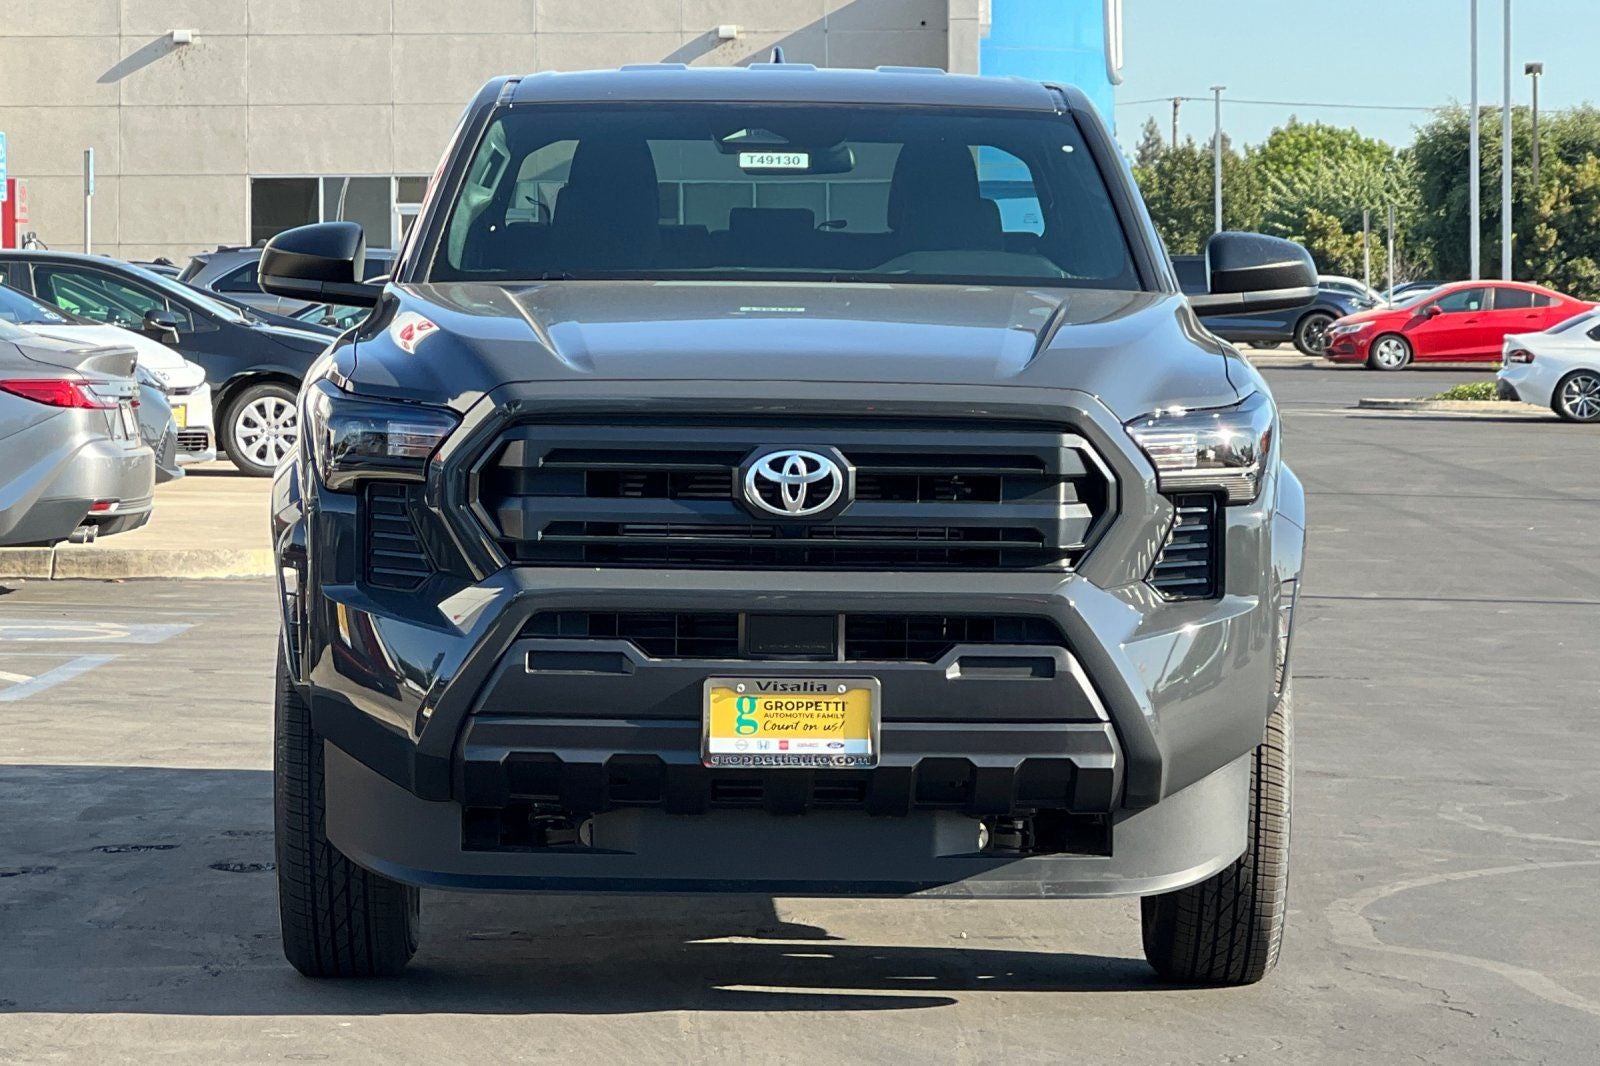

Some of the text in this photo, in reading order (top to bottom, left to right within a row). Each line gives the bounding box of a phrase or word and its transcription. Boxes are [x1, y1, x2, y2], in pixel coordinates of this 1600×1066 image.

[747, 155, 801, 165] T49130
[755, 681, 828, 693] Visalia
[763, 701, 846, 712] GROPPETTI
[763, 720, 846, 732] Count on us!
[710, 753, 871, 766] groppettiauto.com
